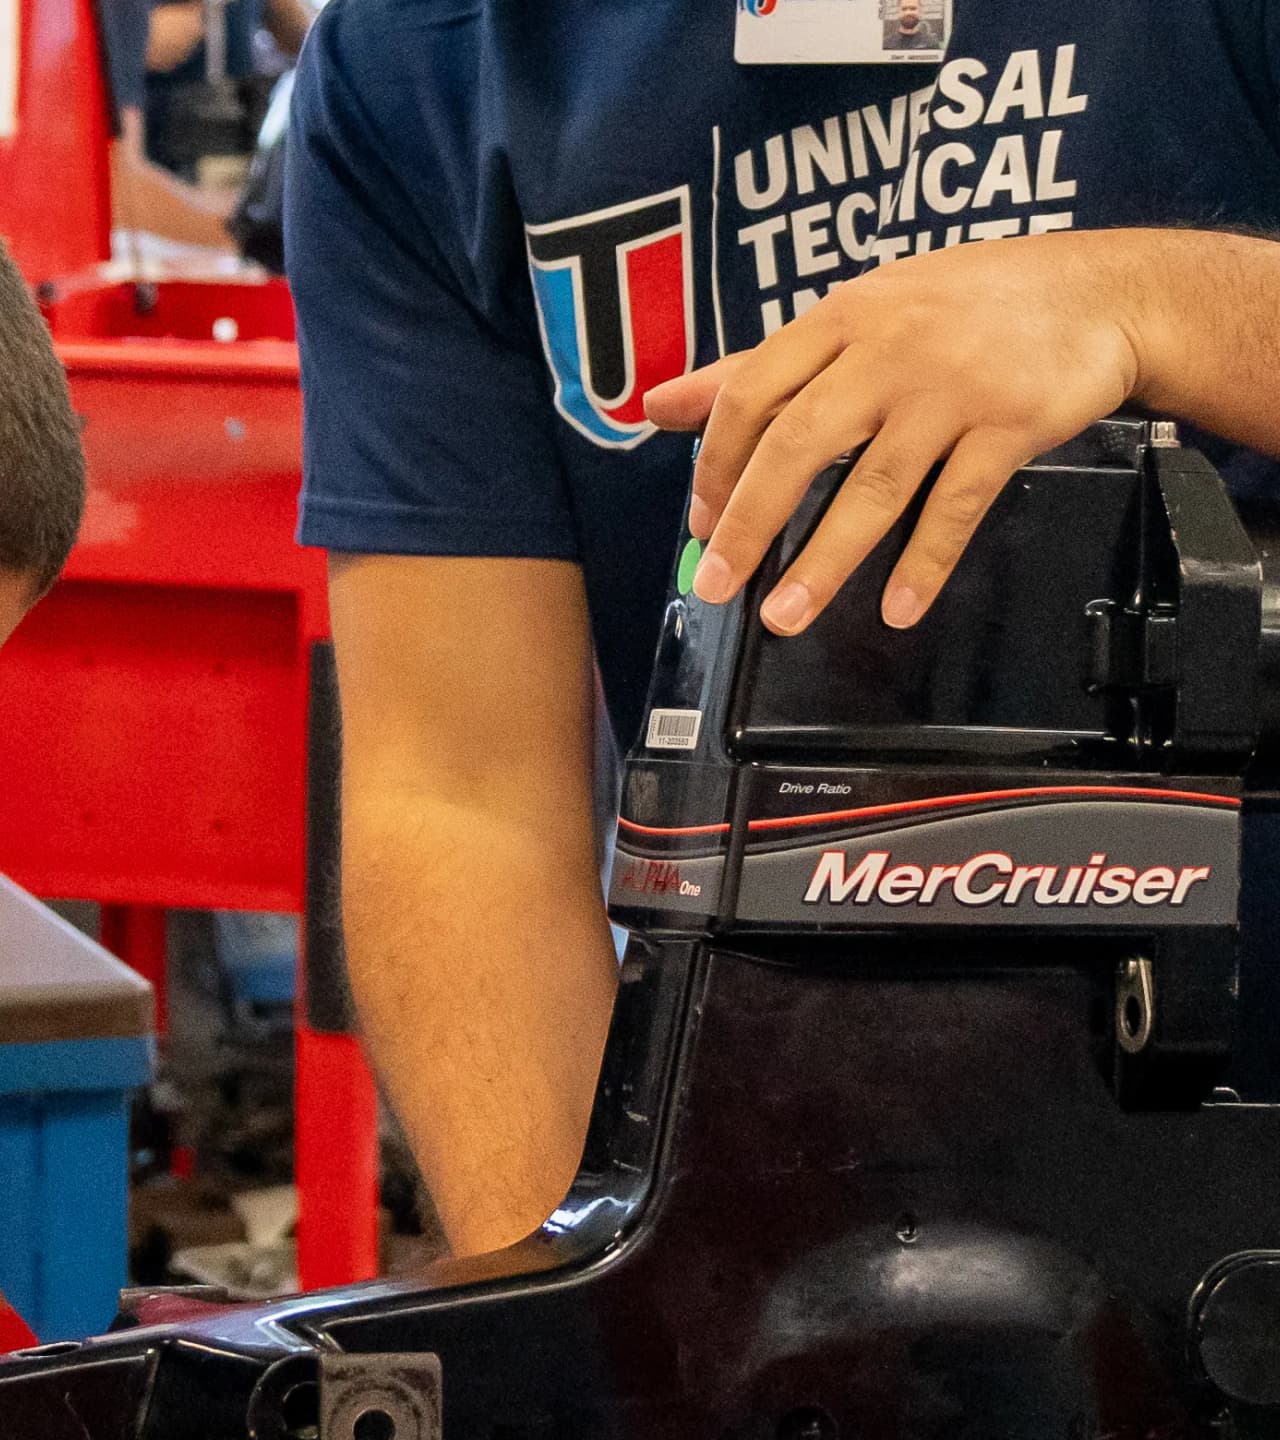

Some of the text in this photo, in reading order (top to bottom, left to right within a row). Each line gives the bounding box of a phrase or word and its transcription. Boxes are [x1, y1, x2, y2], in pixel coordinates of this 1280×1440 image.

[734, 43, 1089, 211] UNIVESAL
[737, 130, 1077, 290] TECICAL
[778, 782, 852, 795] Drive Ratio
[679, 880, 701, 896] One
[802, 849, 1211, 907] MerCruiser
